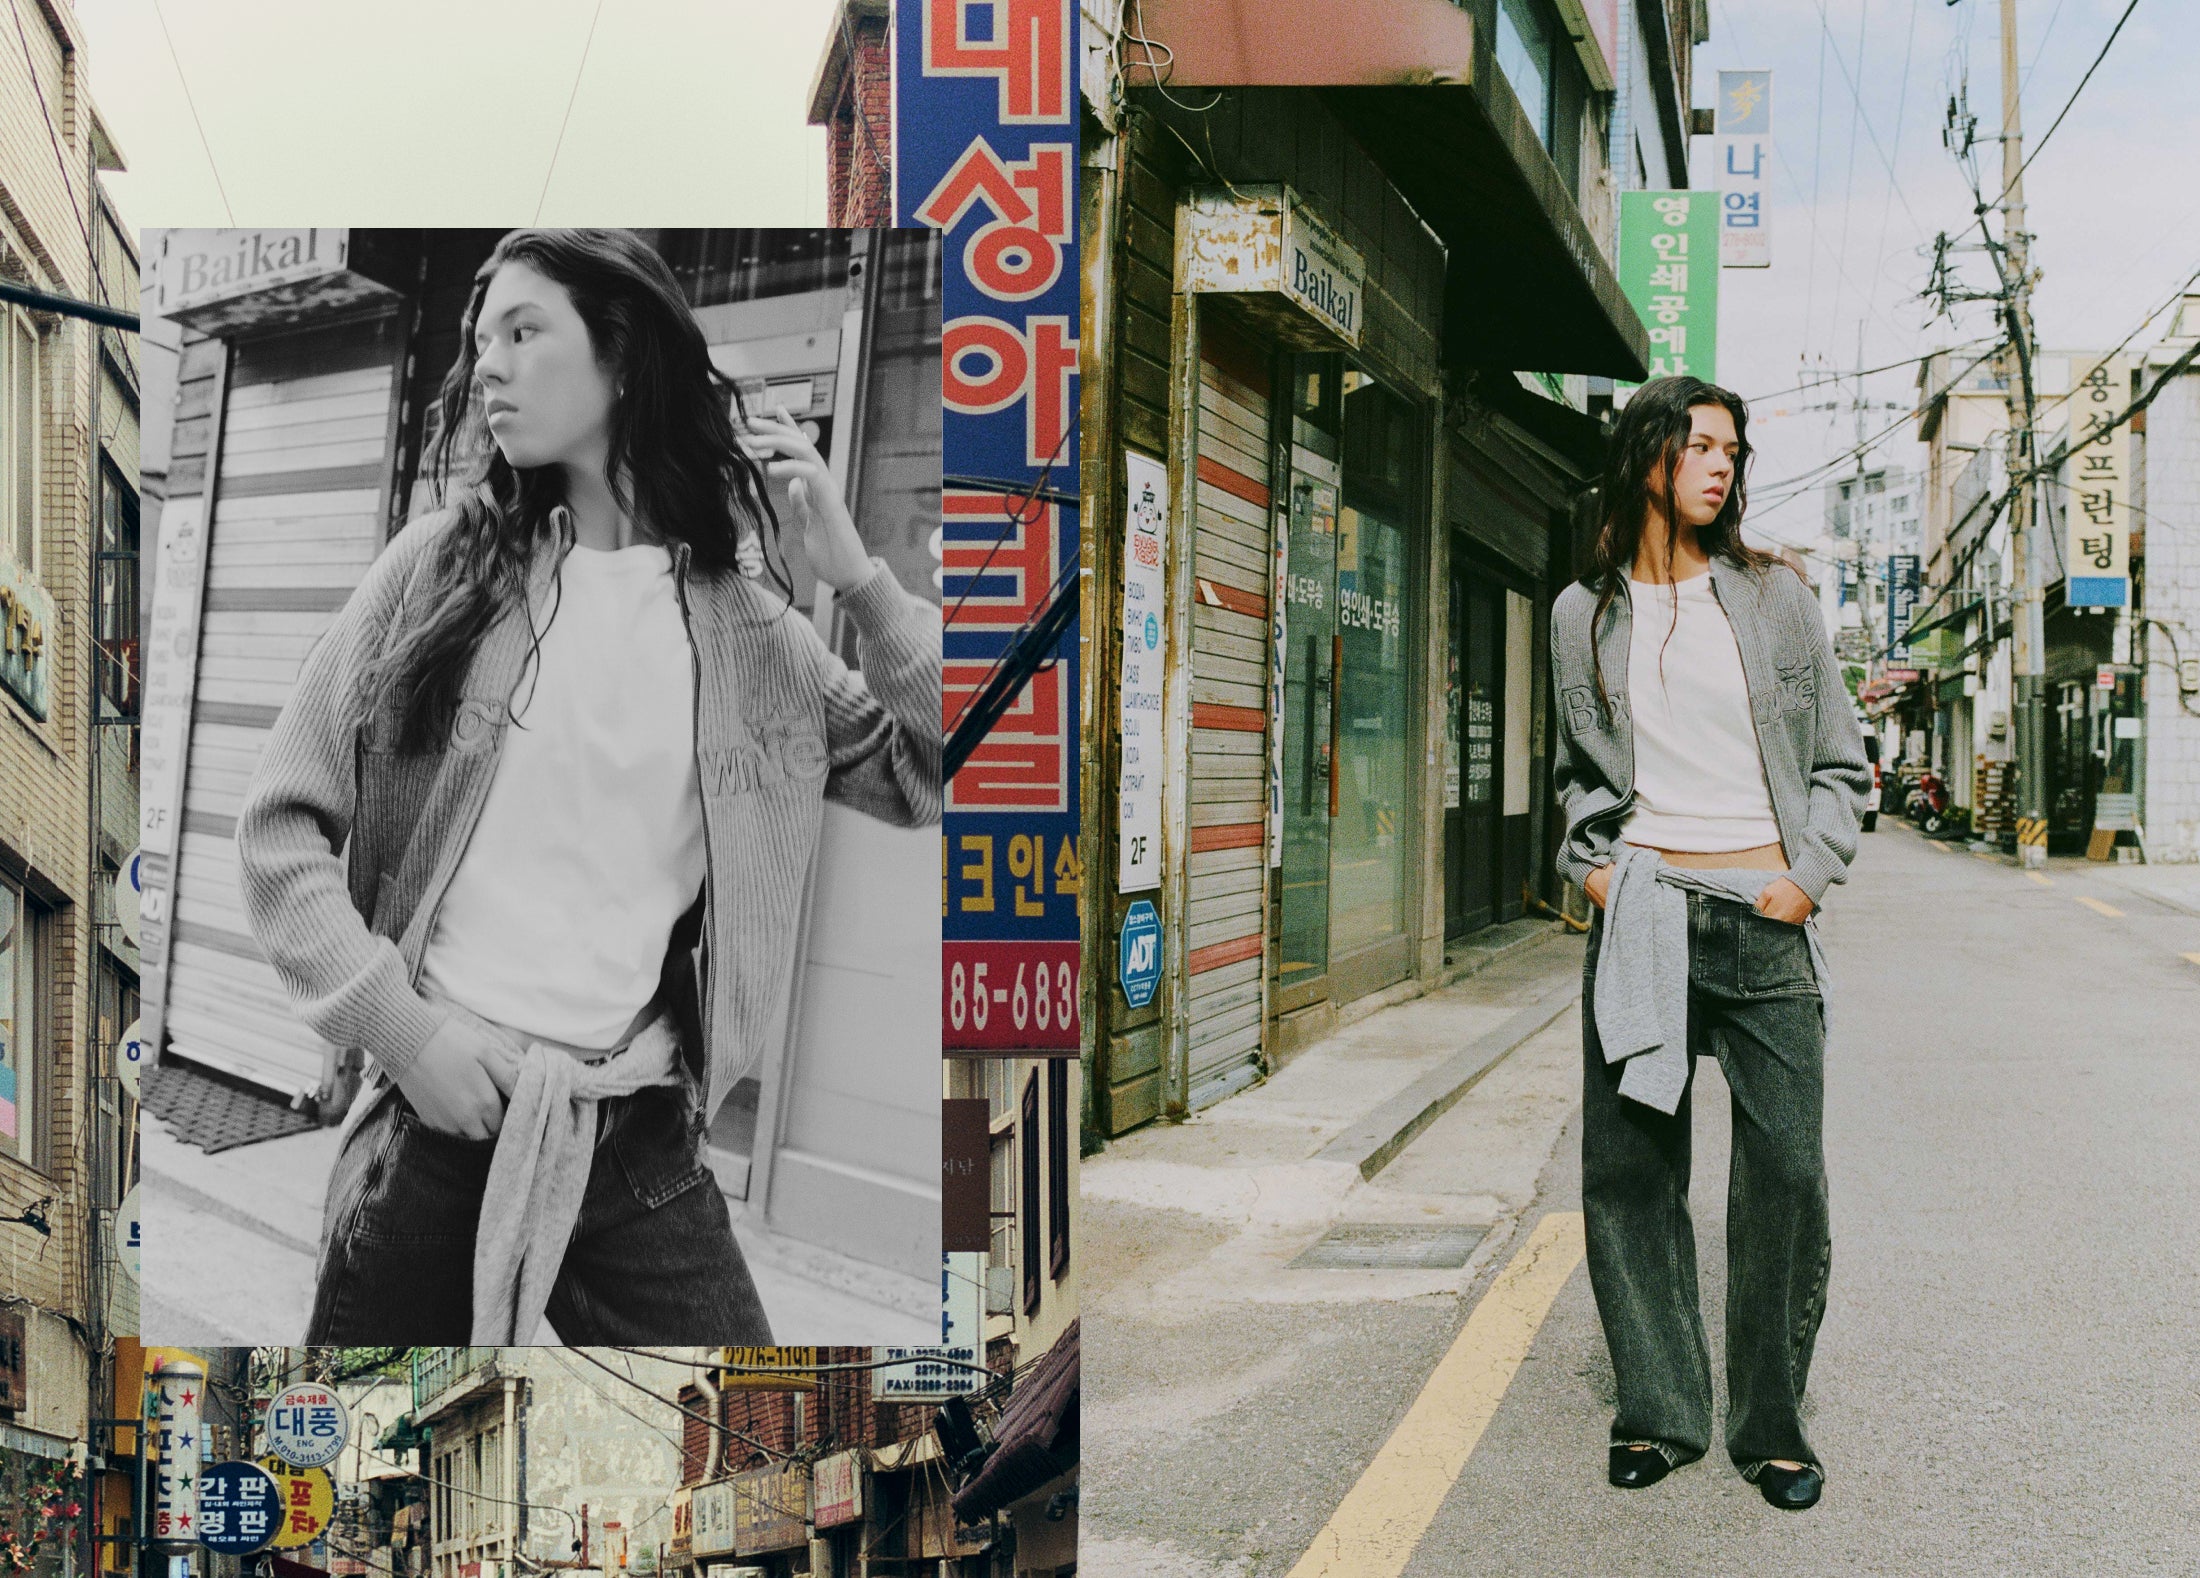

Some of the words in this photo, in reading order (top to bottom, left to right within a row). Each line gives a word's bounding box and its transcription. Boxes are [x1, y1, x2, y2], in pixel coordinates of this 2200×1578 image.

[180, 228, 317, 294] Baikal
[1294, 248, 1354, 332] Baikal
[2080, 366, 2119, 569] 용성프린팅
[146, 808, 167, 830] 2F
[1131, 836, 1147, 866] 2F
[1127, 934, 1157, 974] ADT
[942, 961, 1080, 1031] 85-683
[285, 1394, 328, 1406] 금속제품
[275, 1407, 339, 1437] 대풍
